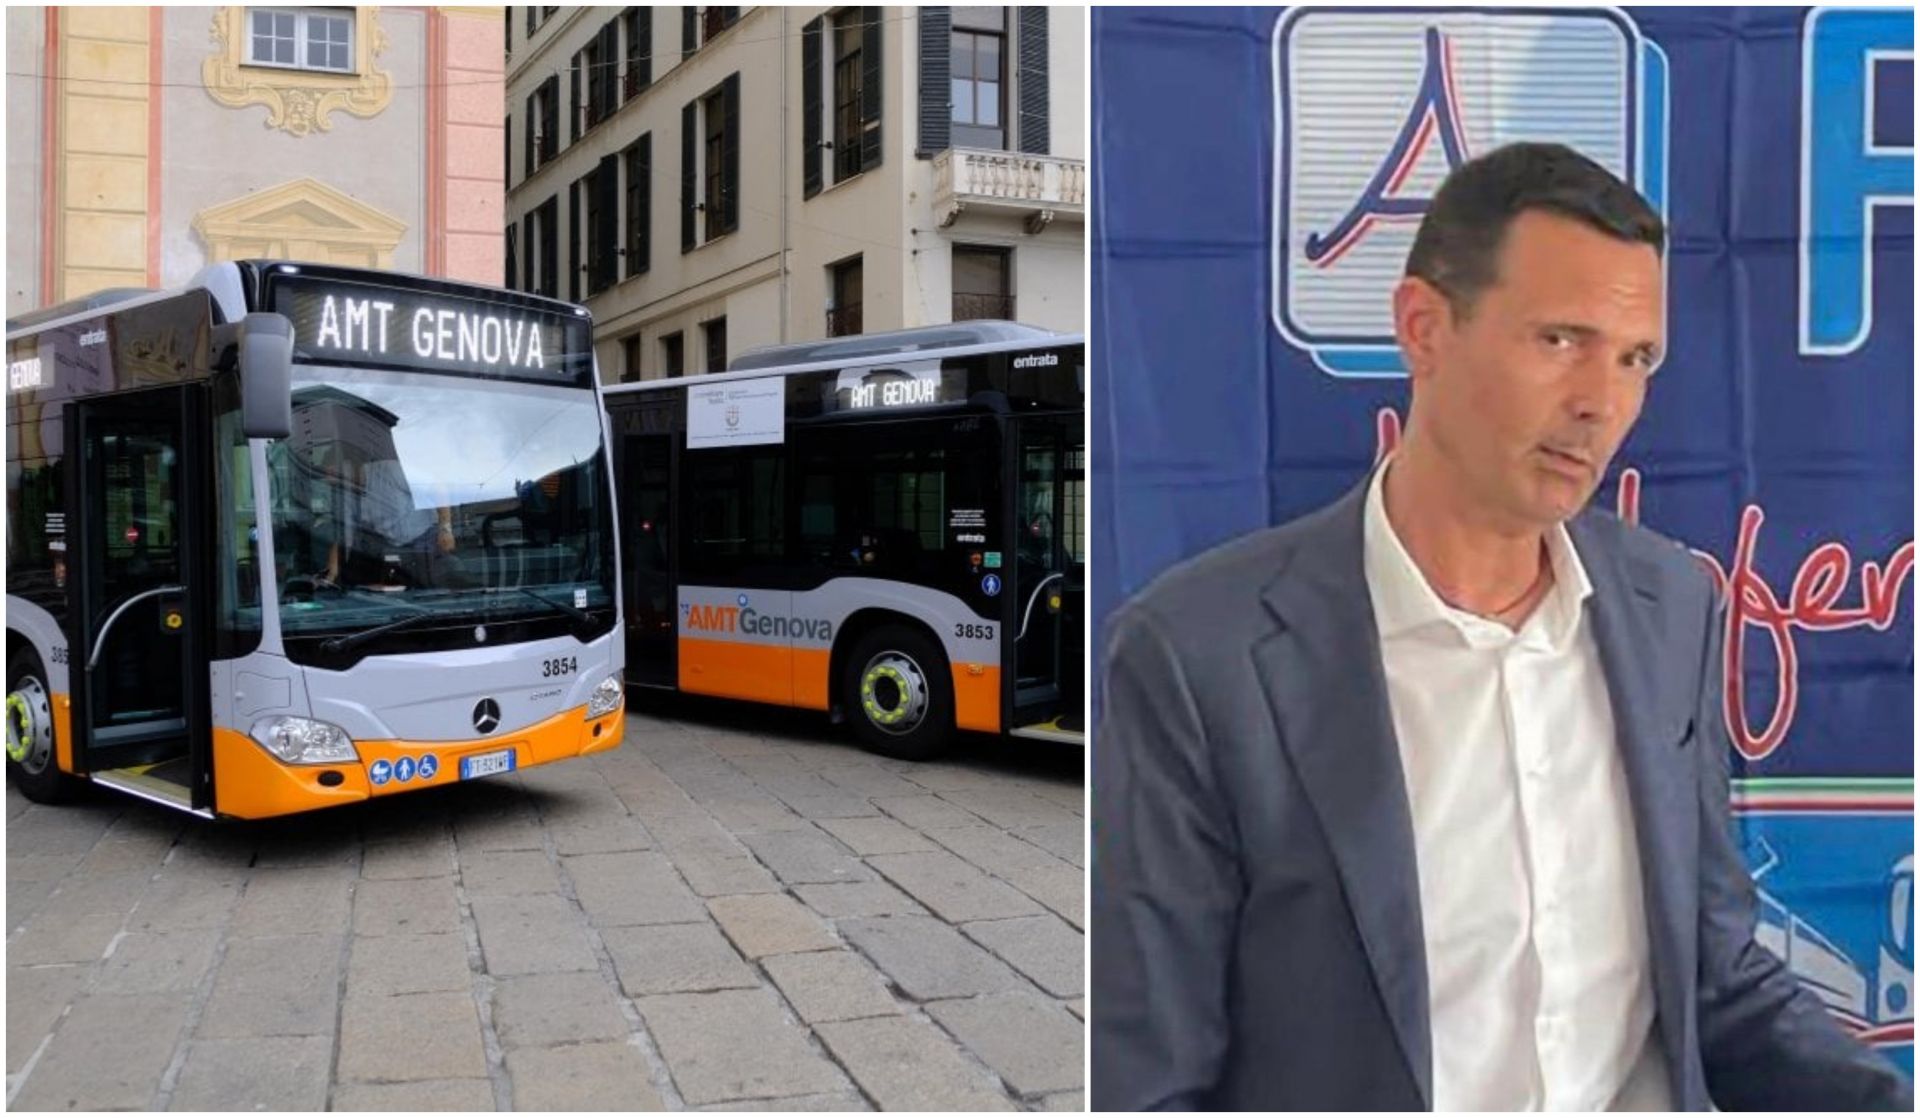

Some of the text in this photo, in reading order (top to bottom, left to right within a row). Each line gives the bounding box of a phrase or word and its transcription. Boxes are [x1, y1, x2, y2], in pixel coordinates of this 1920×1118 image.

[317, 295, 544, 369] AMT GENOVA
[1013, 353, 1058, 369] entrata
[851, 378, 935, 409] AMT GENOVA
[954, 623, 994, 640] 3853
[51, 646, 68, 665] 385
[542, 655, 578, 678] 3854
